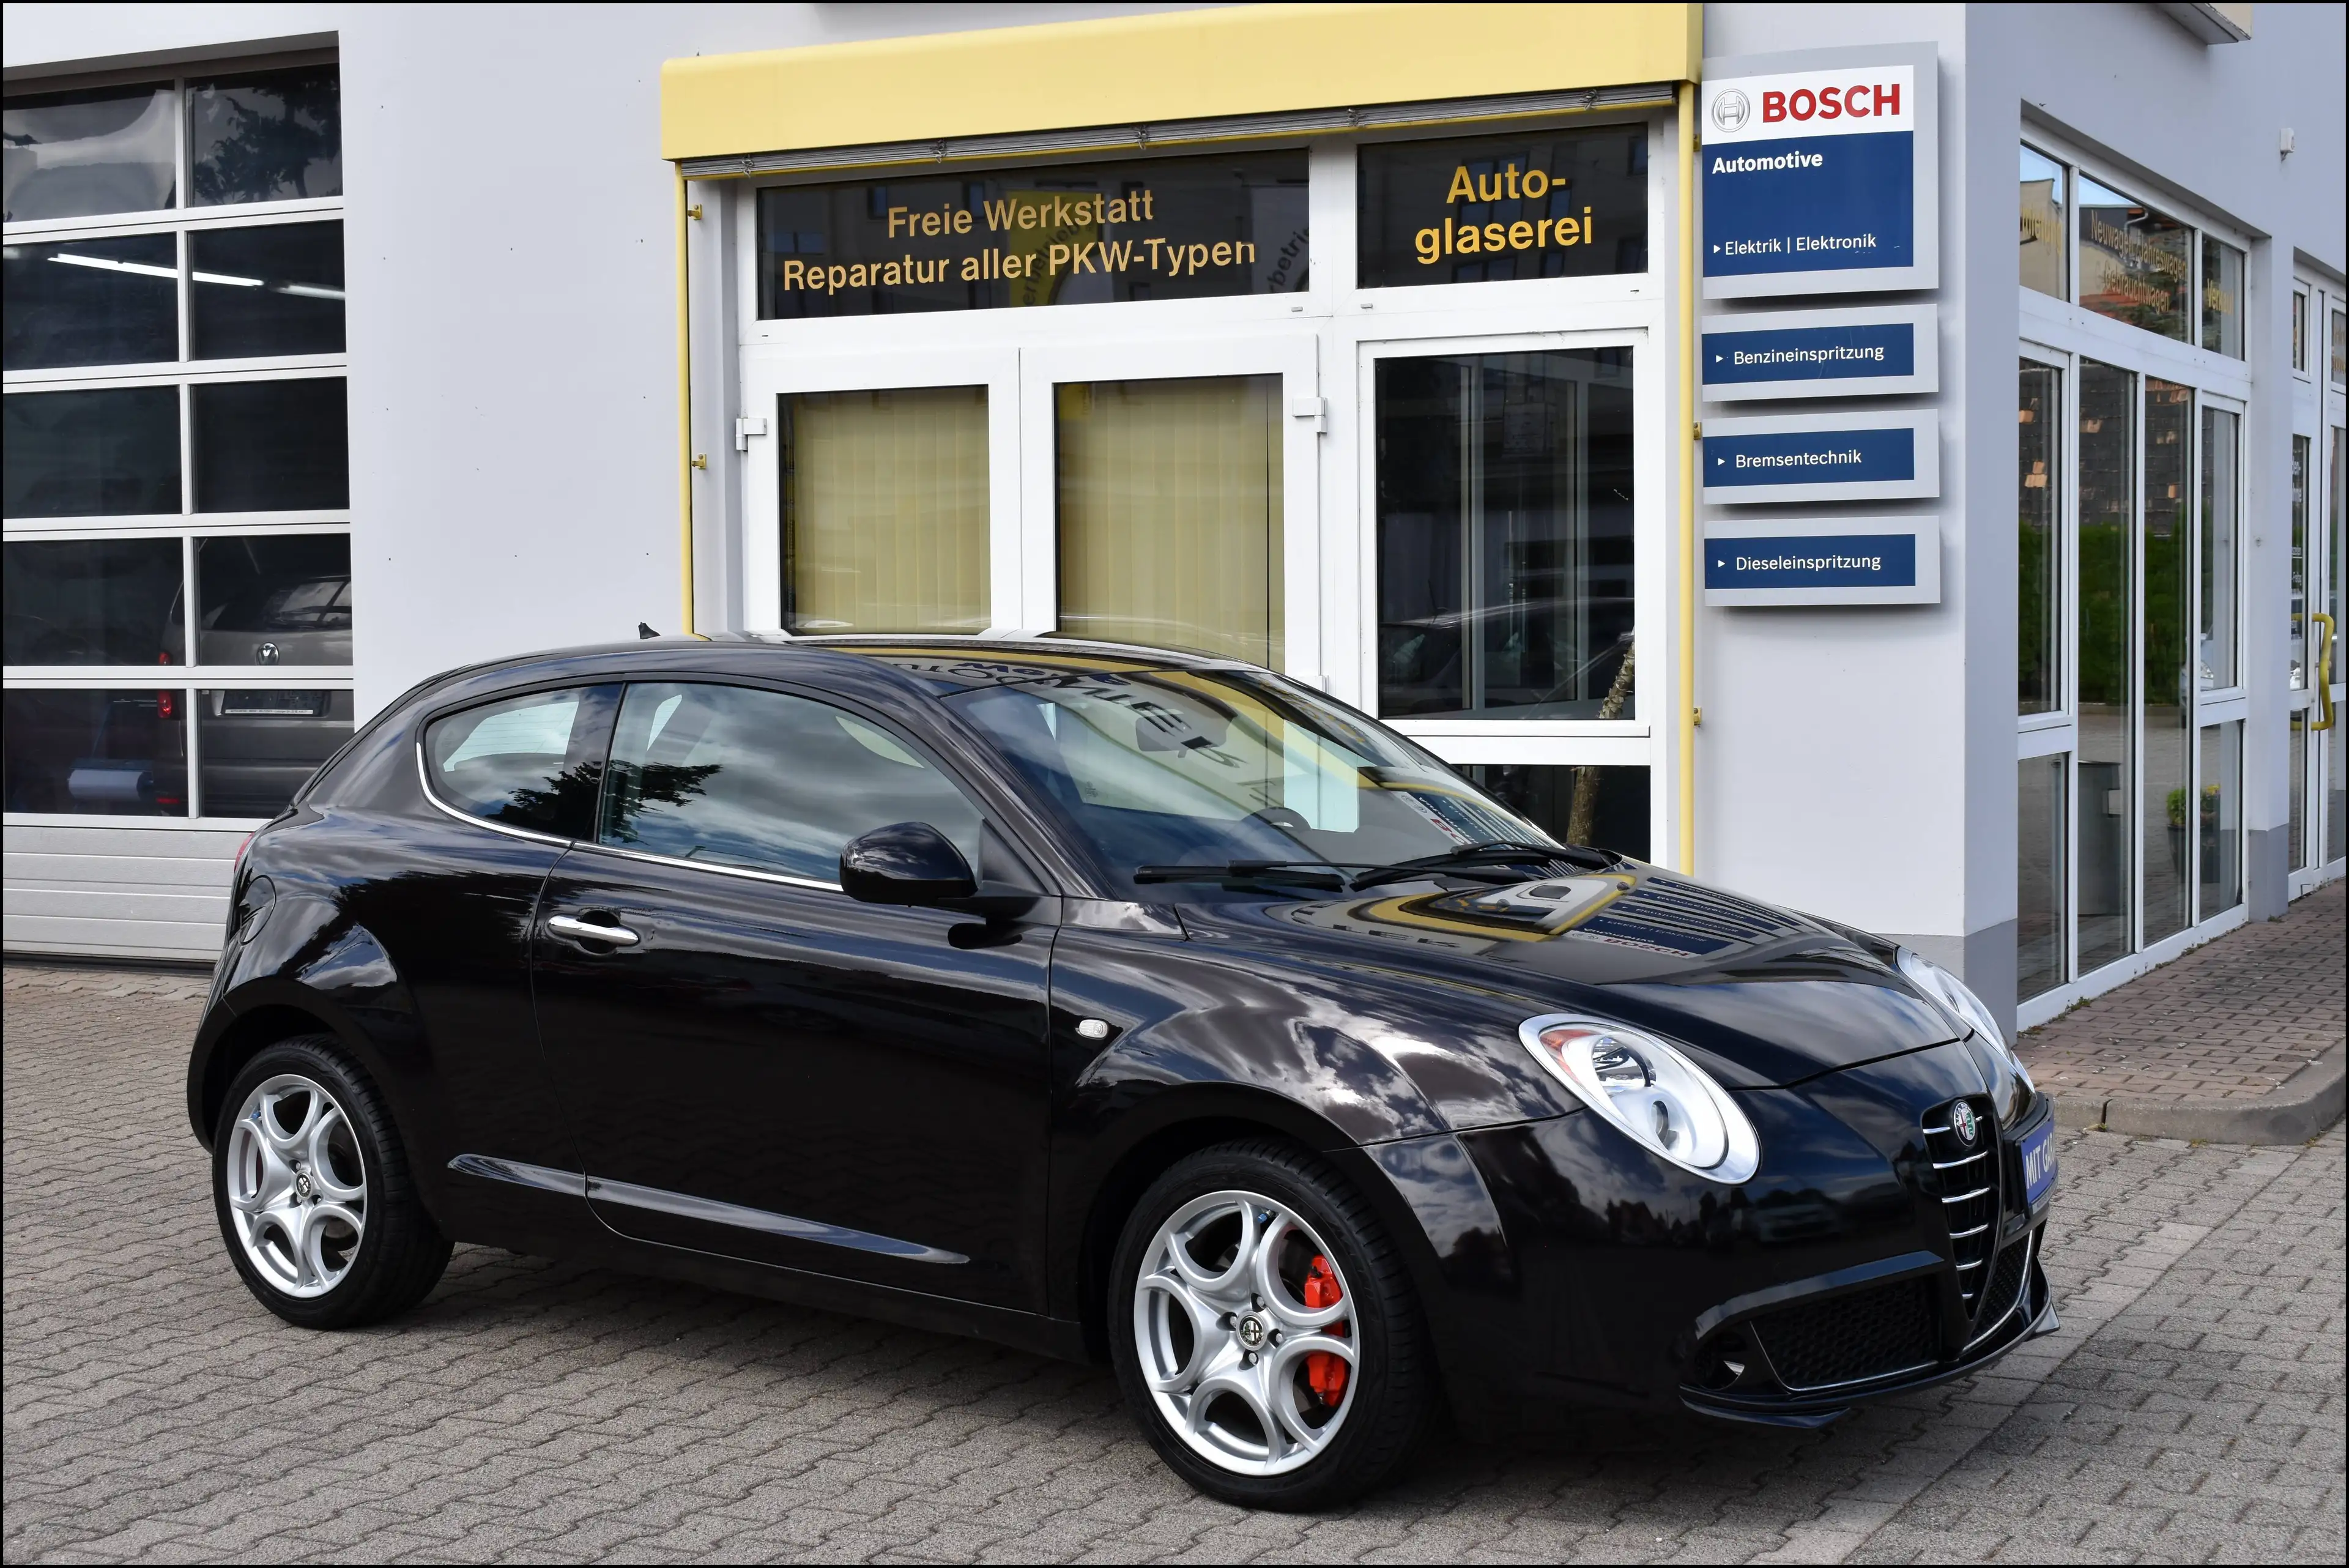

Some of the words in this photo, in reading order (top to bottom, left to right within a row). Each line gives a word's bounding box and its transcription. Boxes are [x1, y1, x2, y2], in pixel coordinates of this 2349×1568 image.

[1763, 84, 1900, 122] BOSCH
[1712, 150, 1823, 174] Automotive
[1446, 163, 1566, 203] Auto-
[889, 204, 973, 238] Freie
[984, 190, 1154, 231] Werkstatt
[1415, 206, 1592, 264] glaserei
[1726, 238, 1781, 255] Elektrik
[1797, 233, 1877, 252] Elektronik
[784, 254, 949, 295] Reparatur
[961, 248, 1037, 281] aller
[1050, 238, 1255, 276] PKW-Typen
[2140, 234, 2187, 283] Jahreswagen
[2105, 259, 2170, 314] Gebrauchtwagen
[1734, 346, 1884, 362] Benzineinspritzung
[1736, 450, 1862, 467] Bremsentechnik
[1736, 554, 1881, 571] Dieseleinspritzung
[2025, 1145, 2041, 1189] MIT
